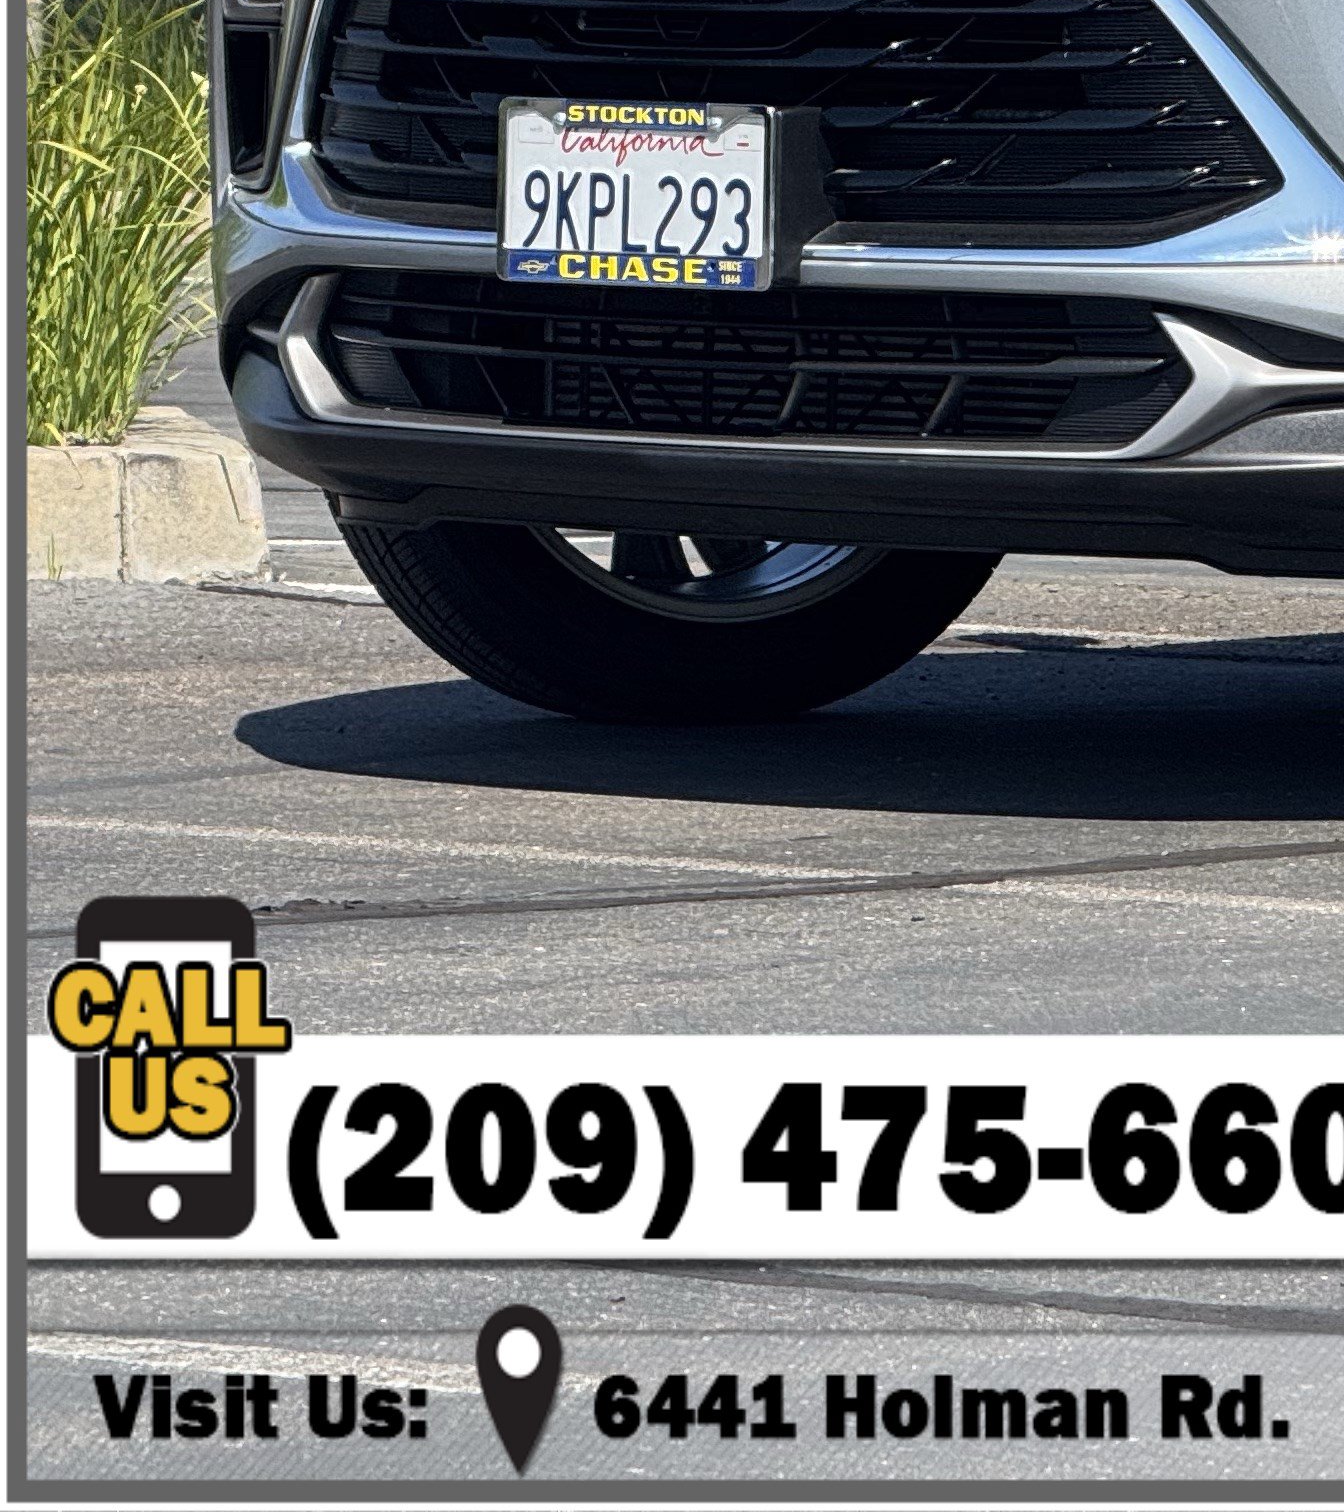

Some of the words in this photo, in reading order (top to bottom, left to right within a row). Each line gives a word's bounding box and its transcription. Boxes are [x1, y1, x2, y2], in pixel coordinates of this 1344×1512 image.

[567, 105, 705, 126] STOCKTON
[560, 127, 725, 168] California
[522, 169, 752, 256] 9KPL293
[558, 253, 708, 285] CHASE
